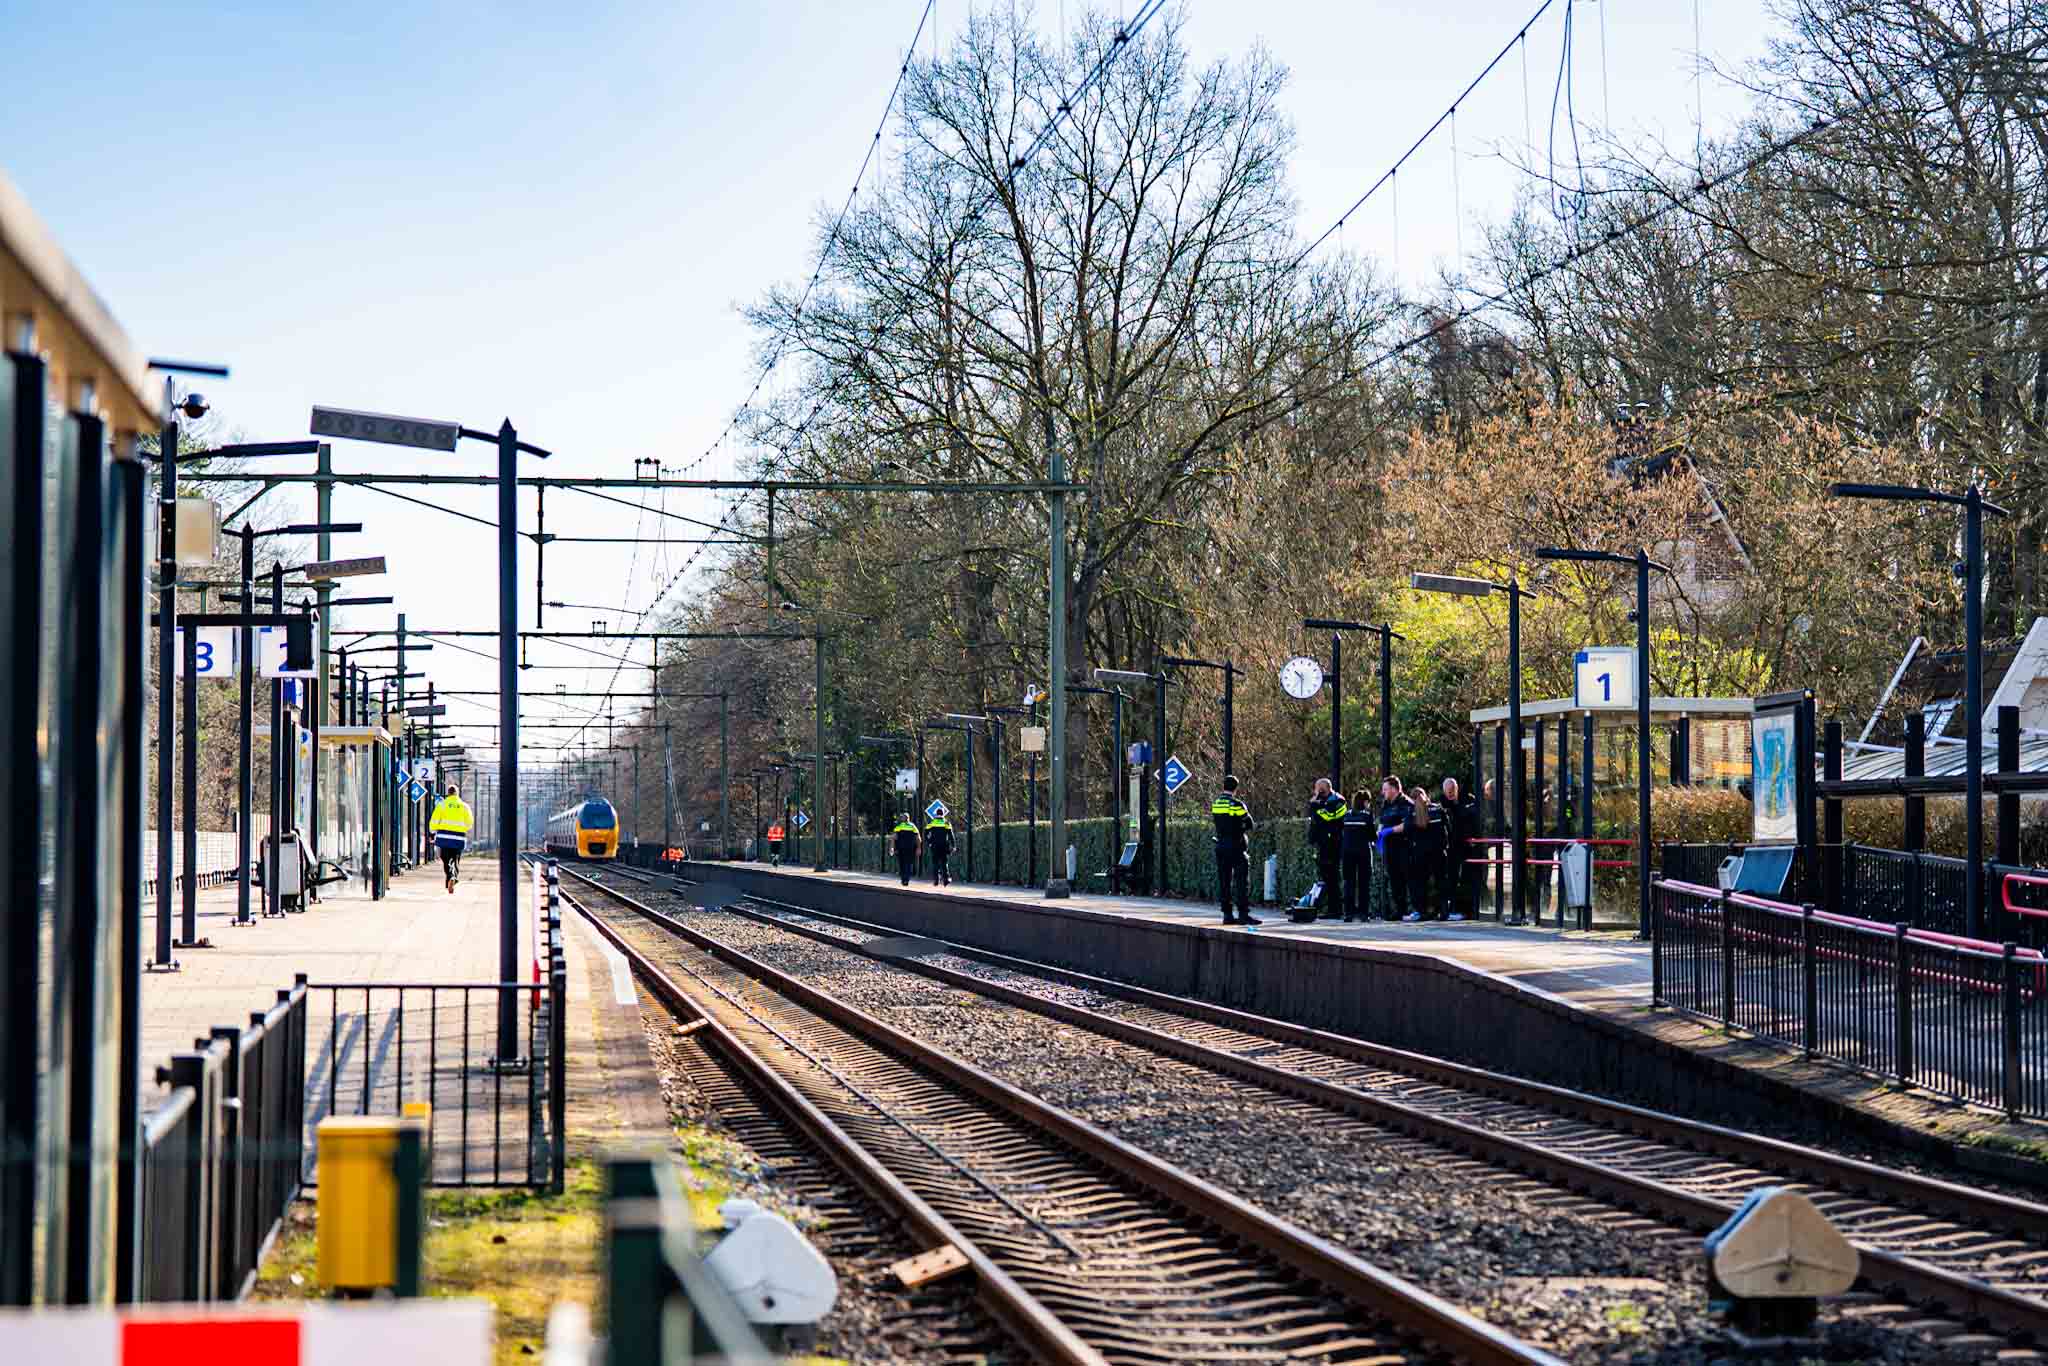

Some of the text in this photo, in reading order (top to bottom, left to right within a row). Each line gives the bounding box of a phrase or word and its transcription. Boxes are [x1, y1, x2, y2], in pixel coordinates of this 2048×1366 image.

[1597, 672, 1610, 701] 1
[421, 767, 429, 779] 2
[1167, 768, 1178, 782] 2
